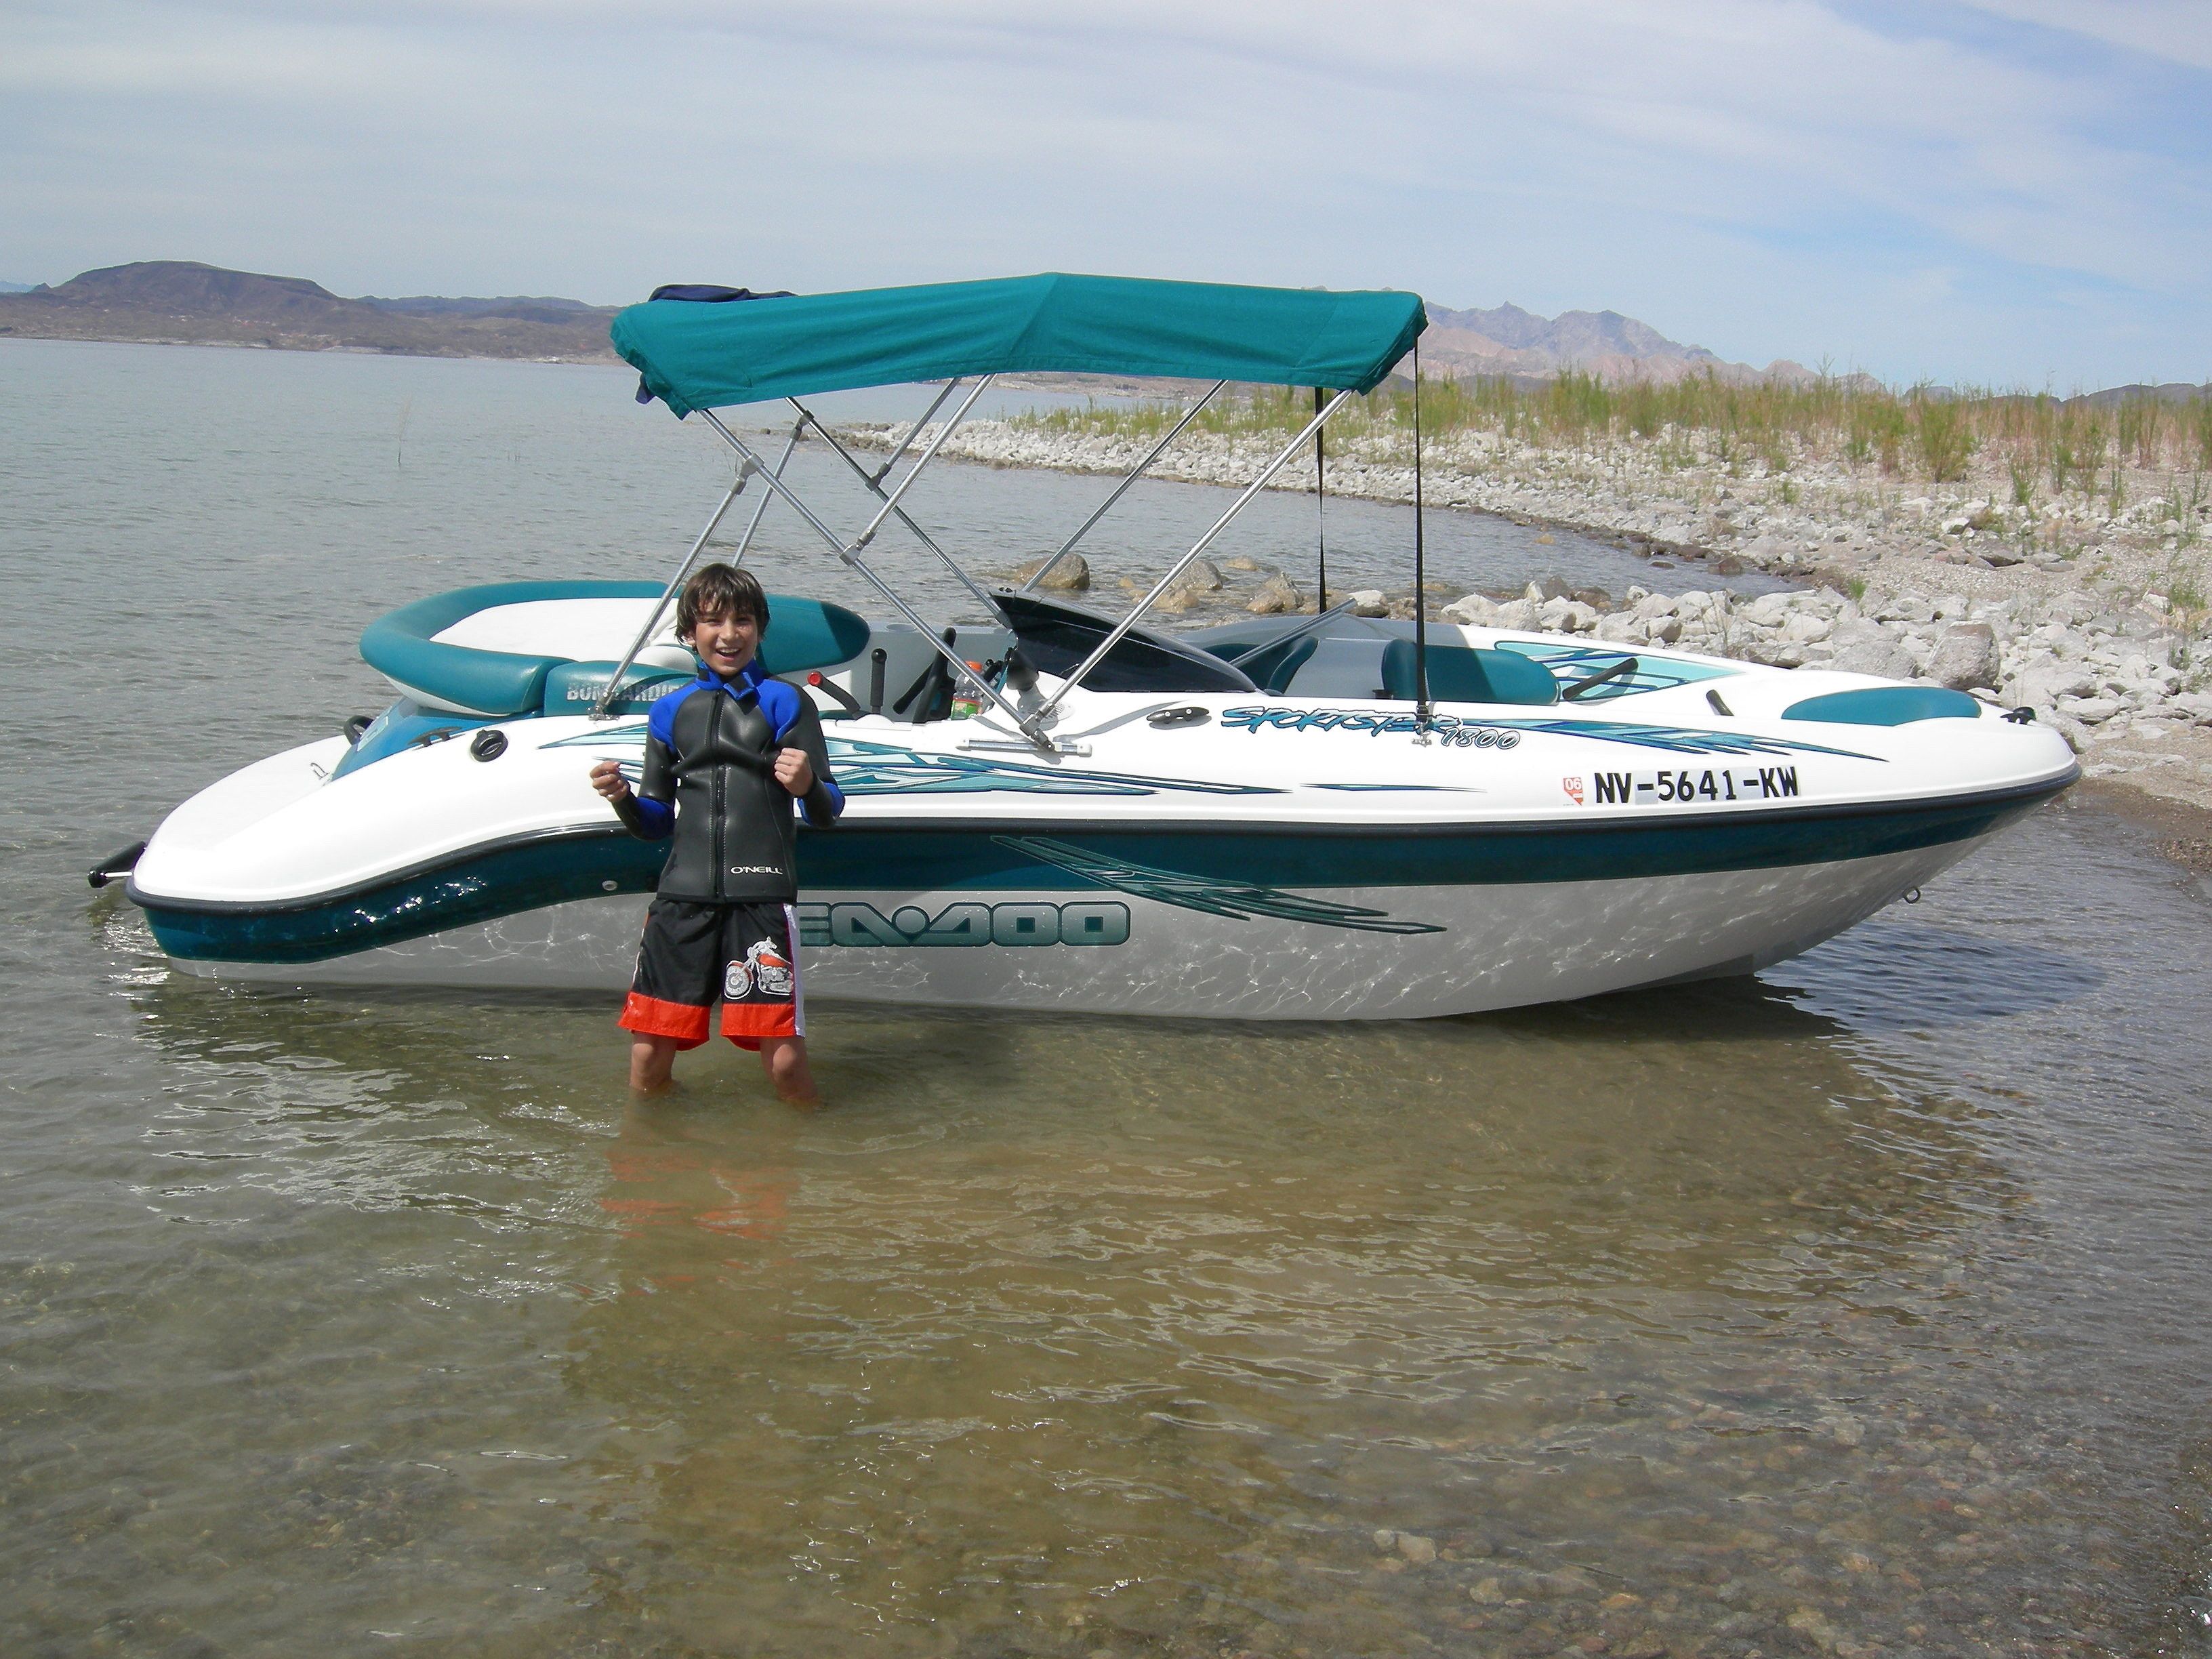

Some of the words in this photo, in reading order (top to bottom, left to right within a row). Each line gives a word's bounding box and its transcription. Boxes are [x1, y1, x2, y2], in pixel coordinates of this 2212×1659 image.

[1221, 706, 1462, 737] SPORTSTER
[1441, 727, 1521, 750] 1800
[1565, 777, 1582, 791] 06
[731, 866, 783, 875] O'NEILL
